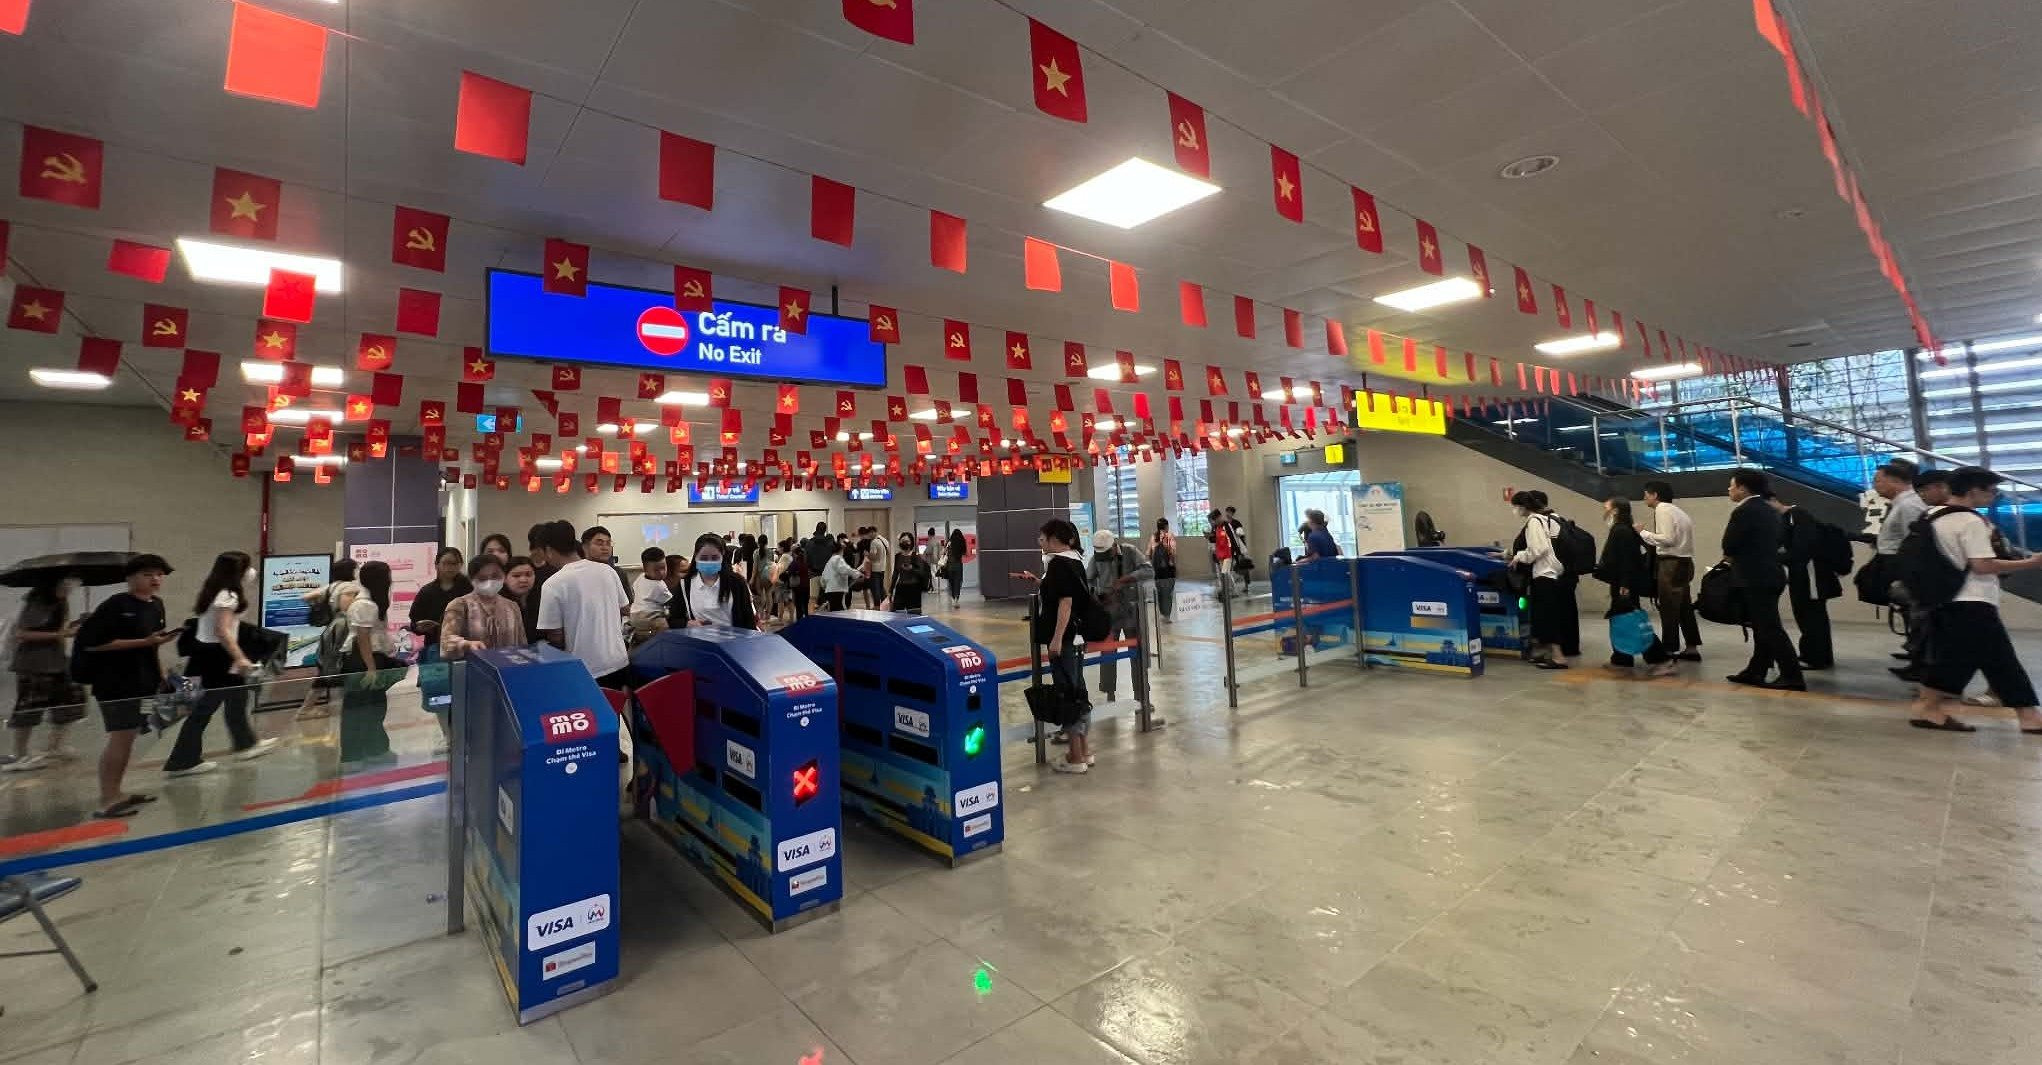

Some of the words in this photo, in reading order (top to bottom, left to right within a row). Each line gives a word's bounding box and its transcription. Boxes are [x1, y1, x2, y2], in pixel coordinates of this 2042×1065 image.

[699, 312, 754, 340] Cấm
[762, 324, 787, 344] ra
[699, 342, 725, 362] No
[730, 345, 761, 365] Exit
[898, 713, 913, 727] VISA
[581, 750, 597, 758] Visa
[960, 795, 980, 809] VISA
[783, 844, 810, 861] VISA
[536, 916, 574, 937] VISA
